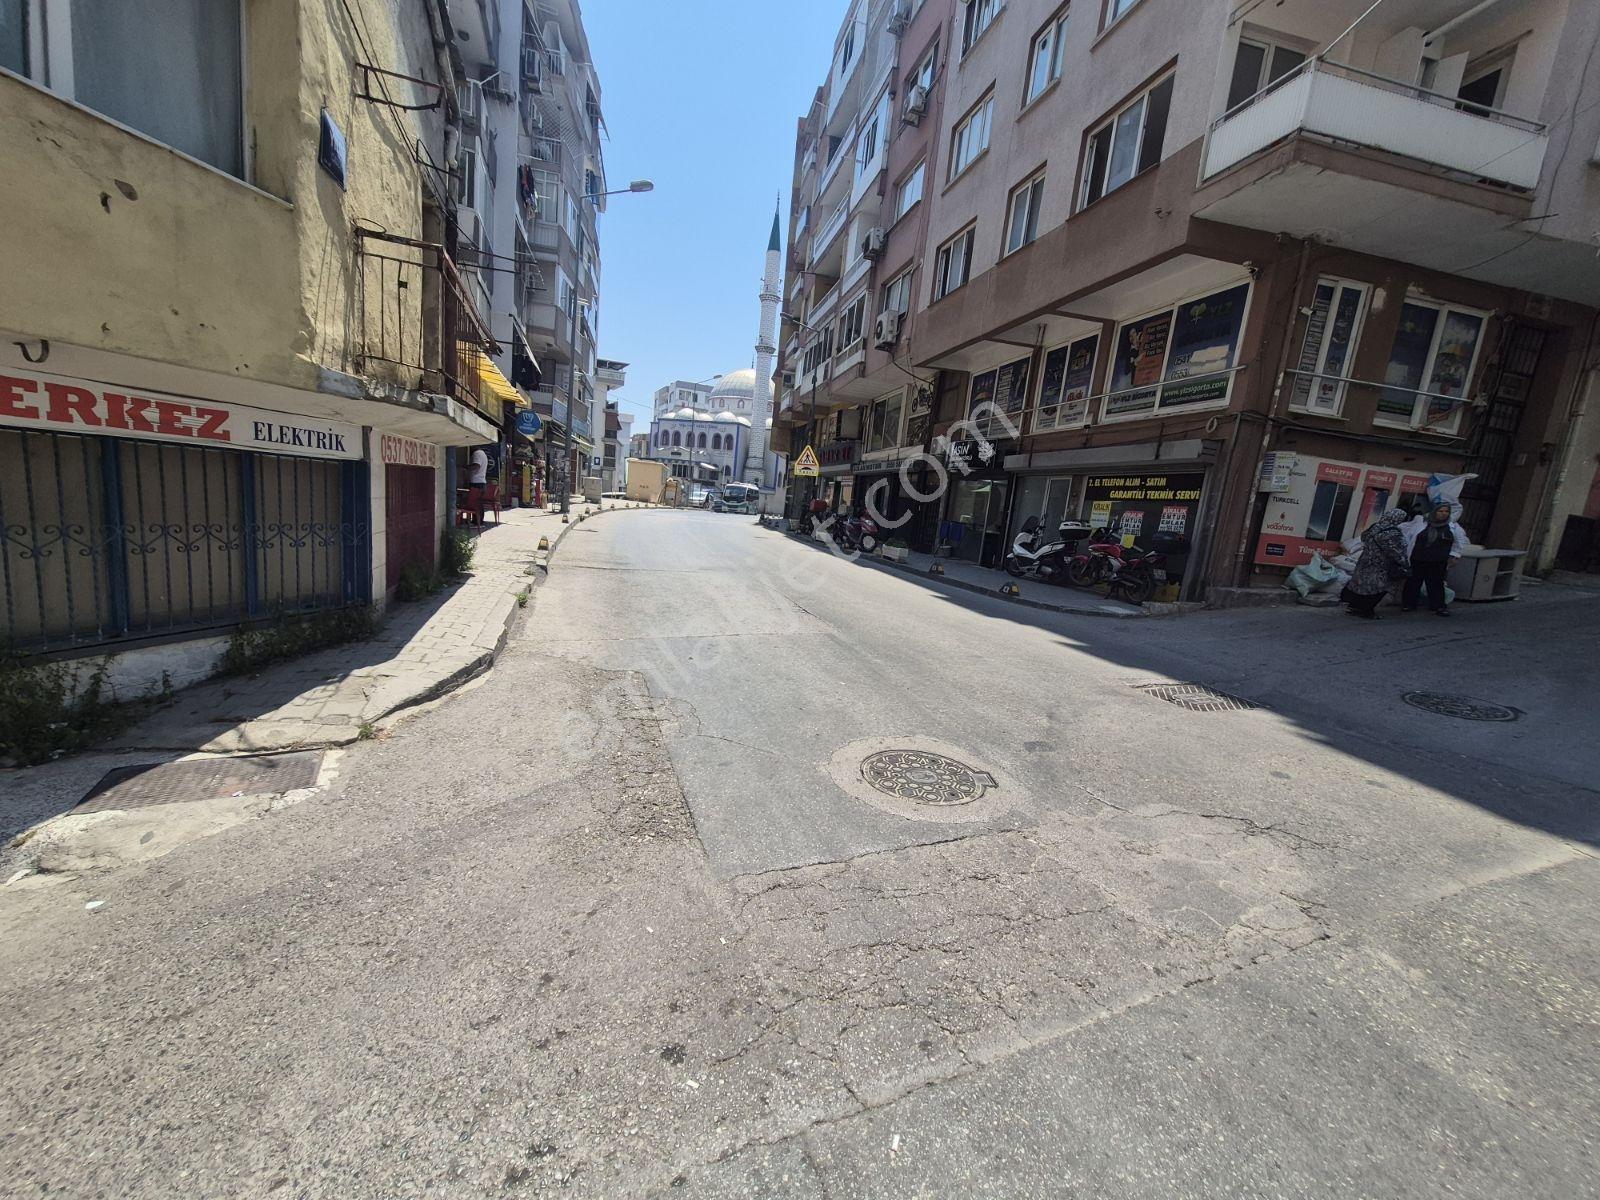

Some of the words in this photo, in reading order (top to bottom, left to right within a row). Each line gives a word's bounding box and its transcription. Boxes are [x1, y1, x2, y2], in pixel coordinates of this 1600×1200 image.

[253, 421, 347, 452] ELEKTRİK
[381, 433, 402, 463] 0537
[404, 439, 418, 465] 620
[1095, 479, 1101, 487] EL
[1101, 478, 1124, 487] TELEFON
[1125, 478, 1141, 486] ALIM
[1146, 477, 1167, 486] SATIM
[1110, 488, 1145, 499] GARANTİLİ
[1146, 488, 1174, 499] TEKNİK
[1266, 522, 1295, 532] vodafone
